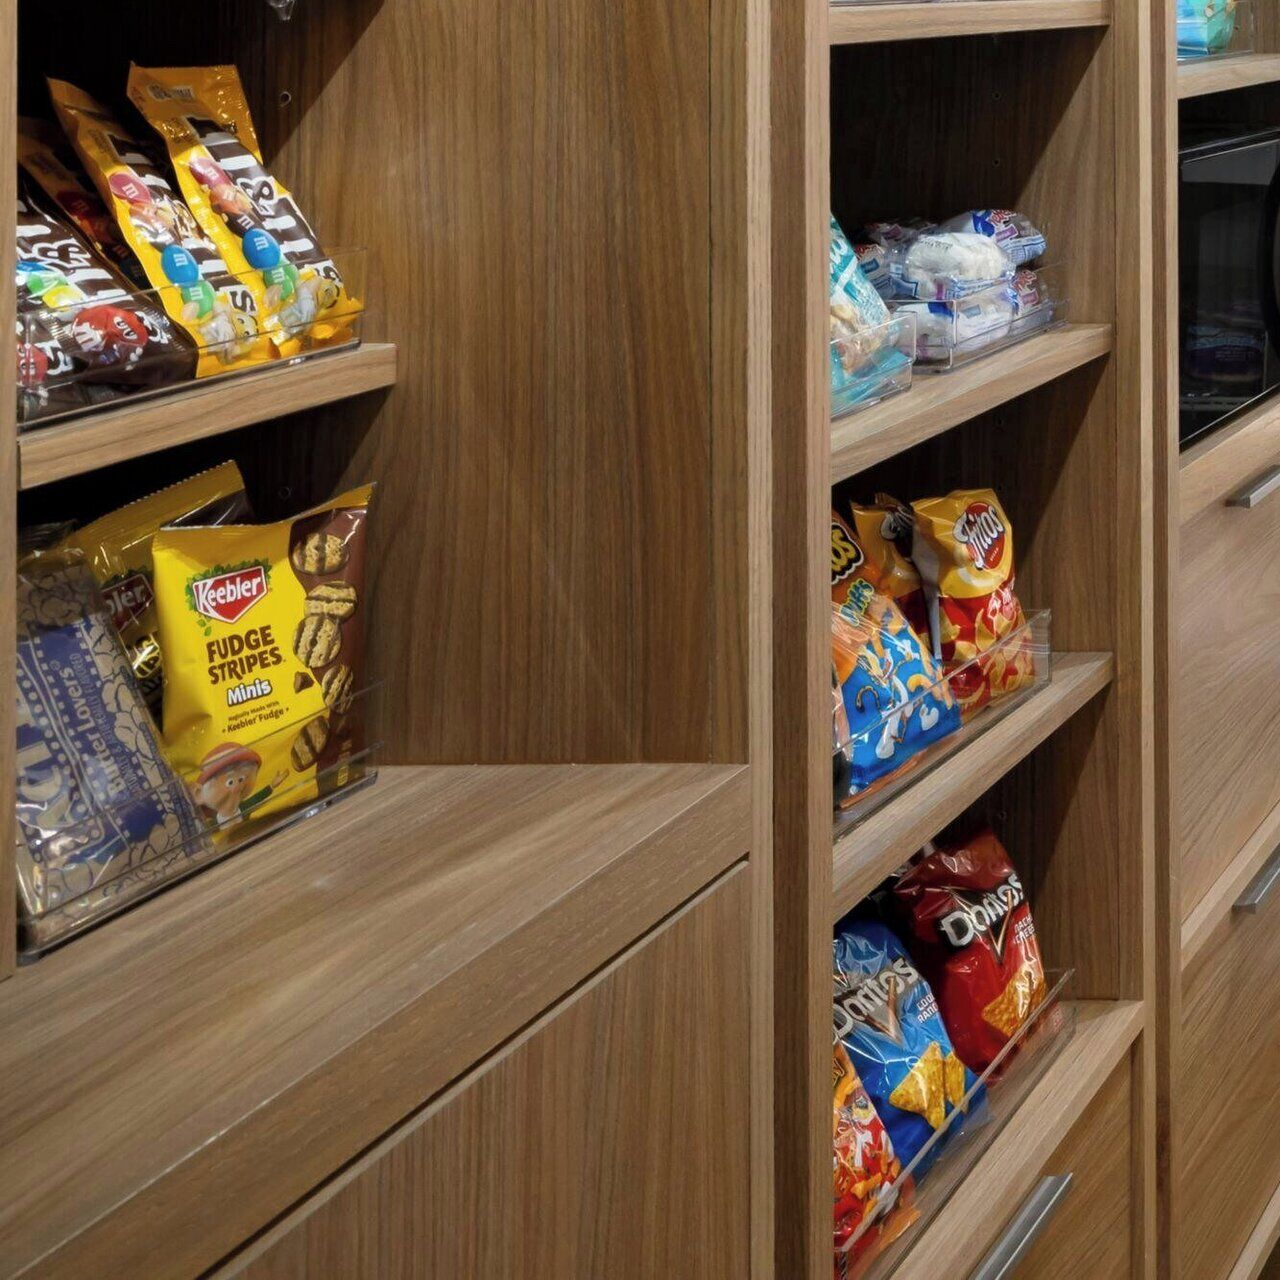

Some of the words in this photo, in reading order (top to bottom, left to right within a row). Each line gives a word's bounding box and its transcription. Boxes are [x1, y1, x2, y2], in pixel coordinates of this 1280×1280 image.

[198, 575, 262, 616] Keebler
[205, 624, 276, 664] FUDGE
[207, 646, 283, 686] STRIPES
[58, 666, 96, 733] Lovers
[227, 678, 273, 708] Minis
[257, 707, 285, 724] Fudge
[940, 872, 1025, 949] Doritos
